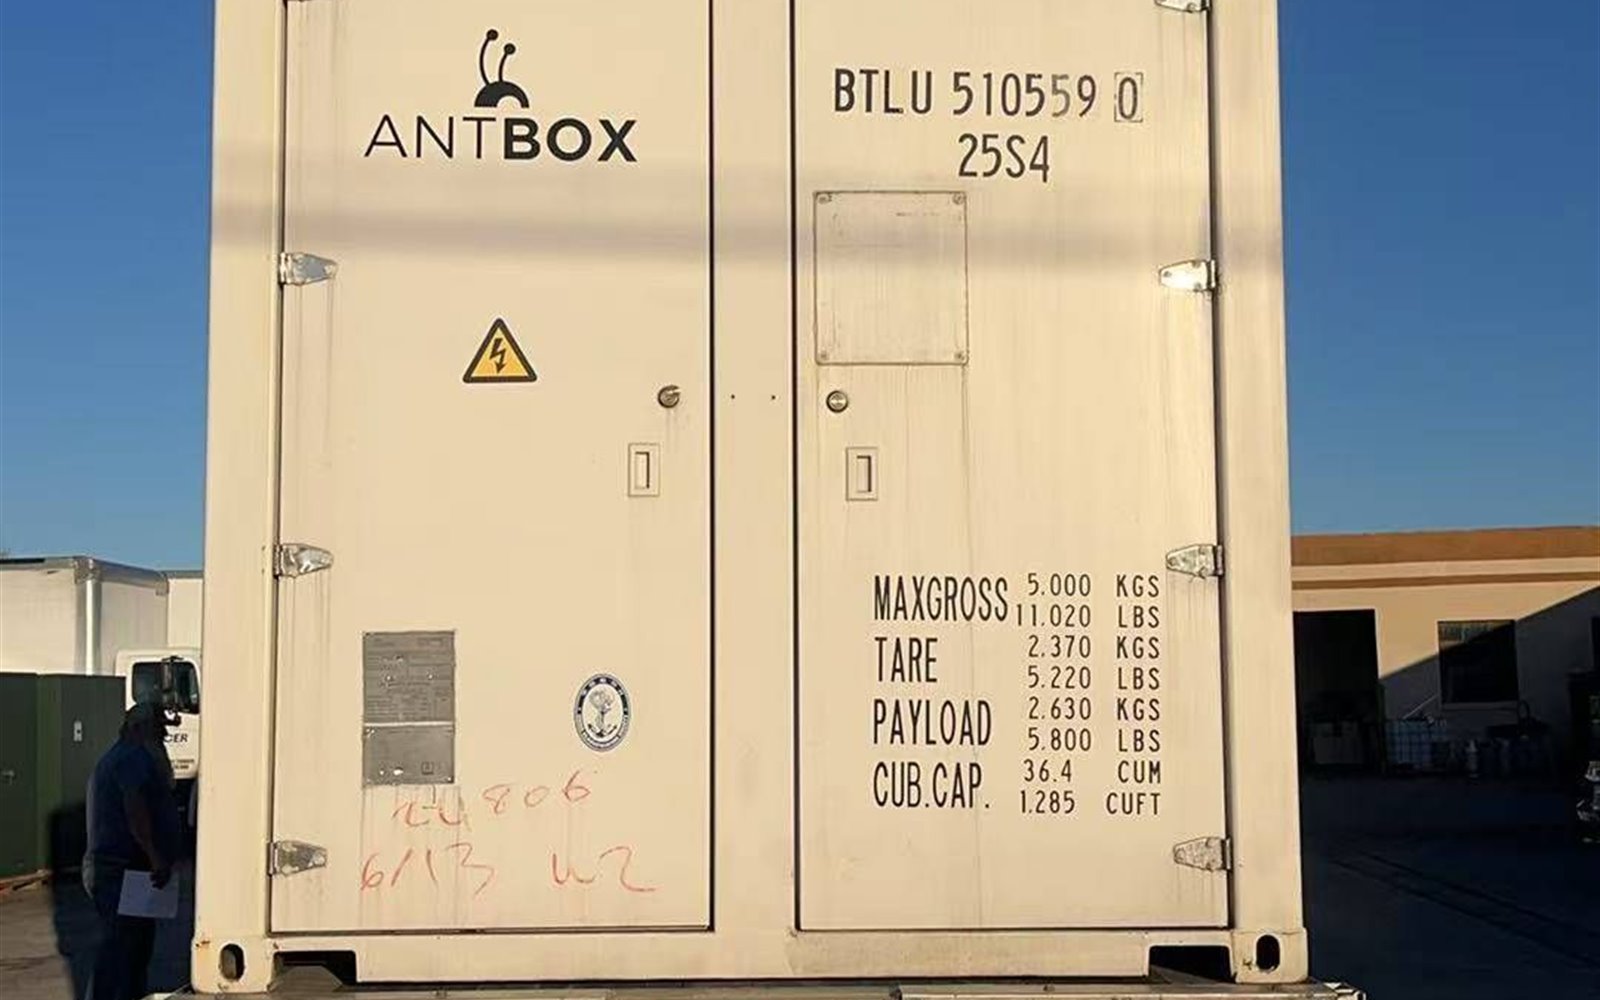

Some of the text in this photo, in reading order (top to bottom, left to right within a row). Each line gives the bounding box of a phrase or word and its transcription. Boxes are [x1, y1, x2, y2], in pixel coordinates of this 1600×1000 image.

[834, 67, 932, 115] BTLU
[952, 71, 1097, 118] 510559
[363, 114, 638, 163] ANTBOX
[958, 133, 1050, 184] 25S4
[874, 574, 1009, 622] MAXGROSS
[1027, 572, 1160, 598] 5.000 KGS
[1016, 603, 1160, 629] 11.020 LBS
[874, 636, 939, 683] TARE
[1028, 634, 1160, 660] 2.370 KGS
[1027, 664, 1160, 691] 5.220 LBS
[873, 698, 992, 746] PAYLOAD
[1028, 695, 1160, 722] 2.630 KGS
[1028, 726, 1161, 753] 5.800 LBS
[1023, 758, 1161, 784] 36.4 CUM
[1020, 789, 1161, 816] 1.285 CUFT
